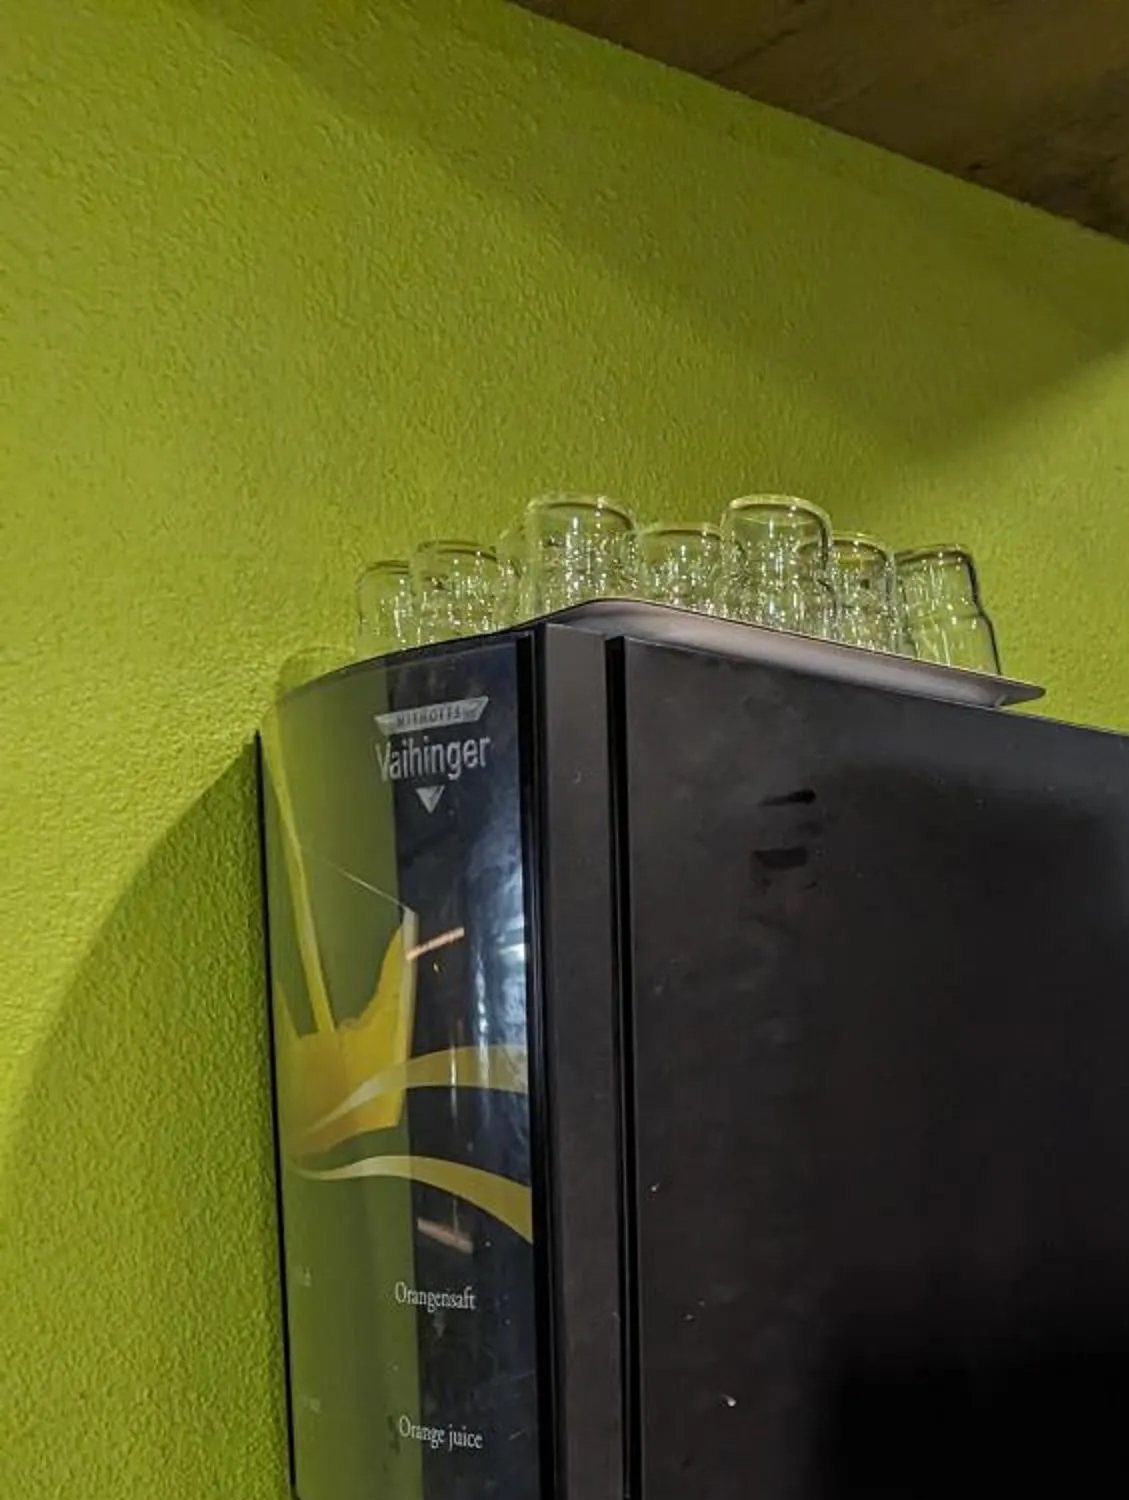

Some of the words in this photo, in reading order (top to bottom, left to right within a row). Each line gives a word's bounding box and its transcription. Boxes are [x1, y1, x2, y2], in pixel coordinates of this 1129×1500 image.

[375, 735, 491, 781] Vaihinger
[395, 1281, 477, 1313] Orangensaft
[400, 1415, 445, 1448] Orange
[448, 1424, 483, 1452] juice
